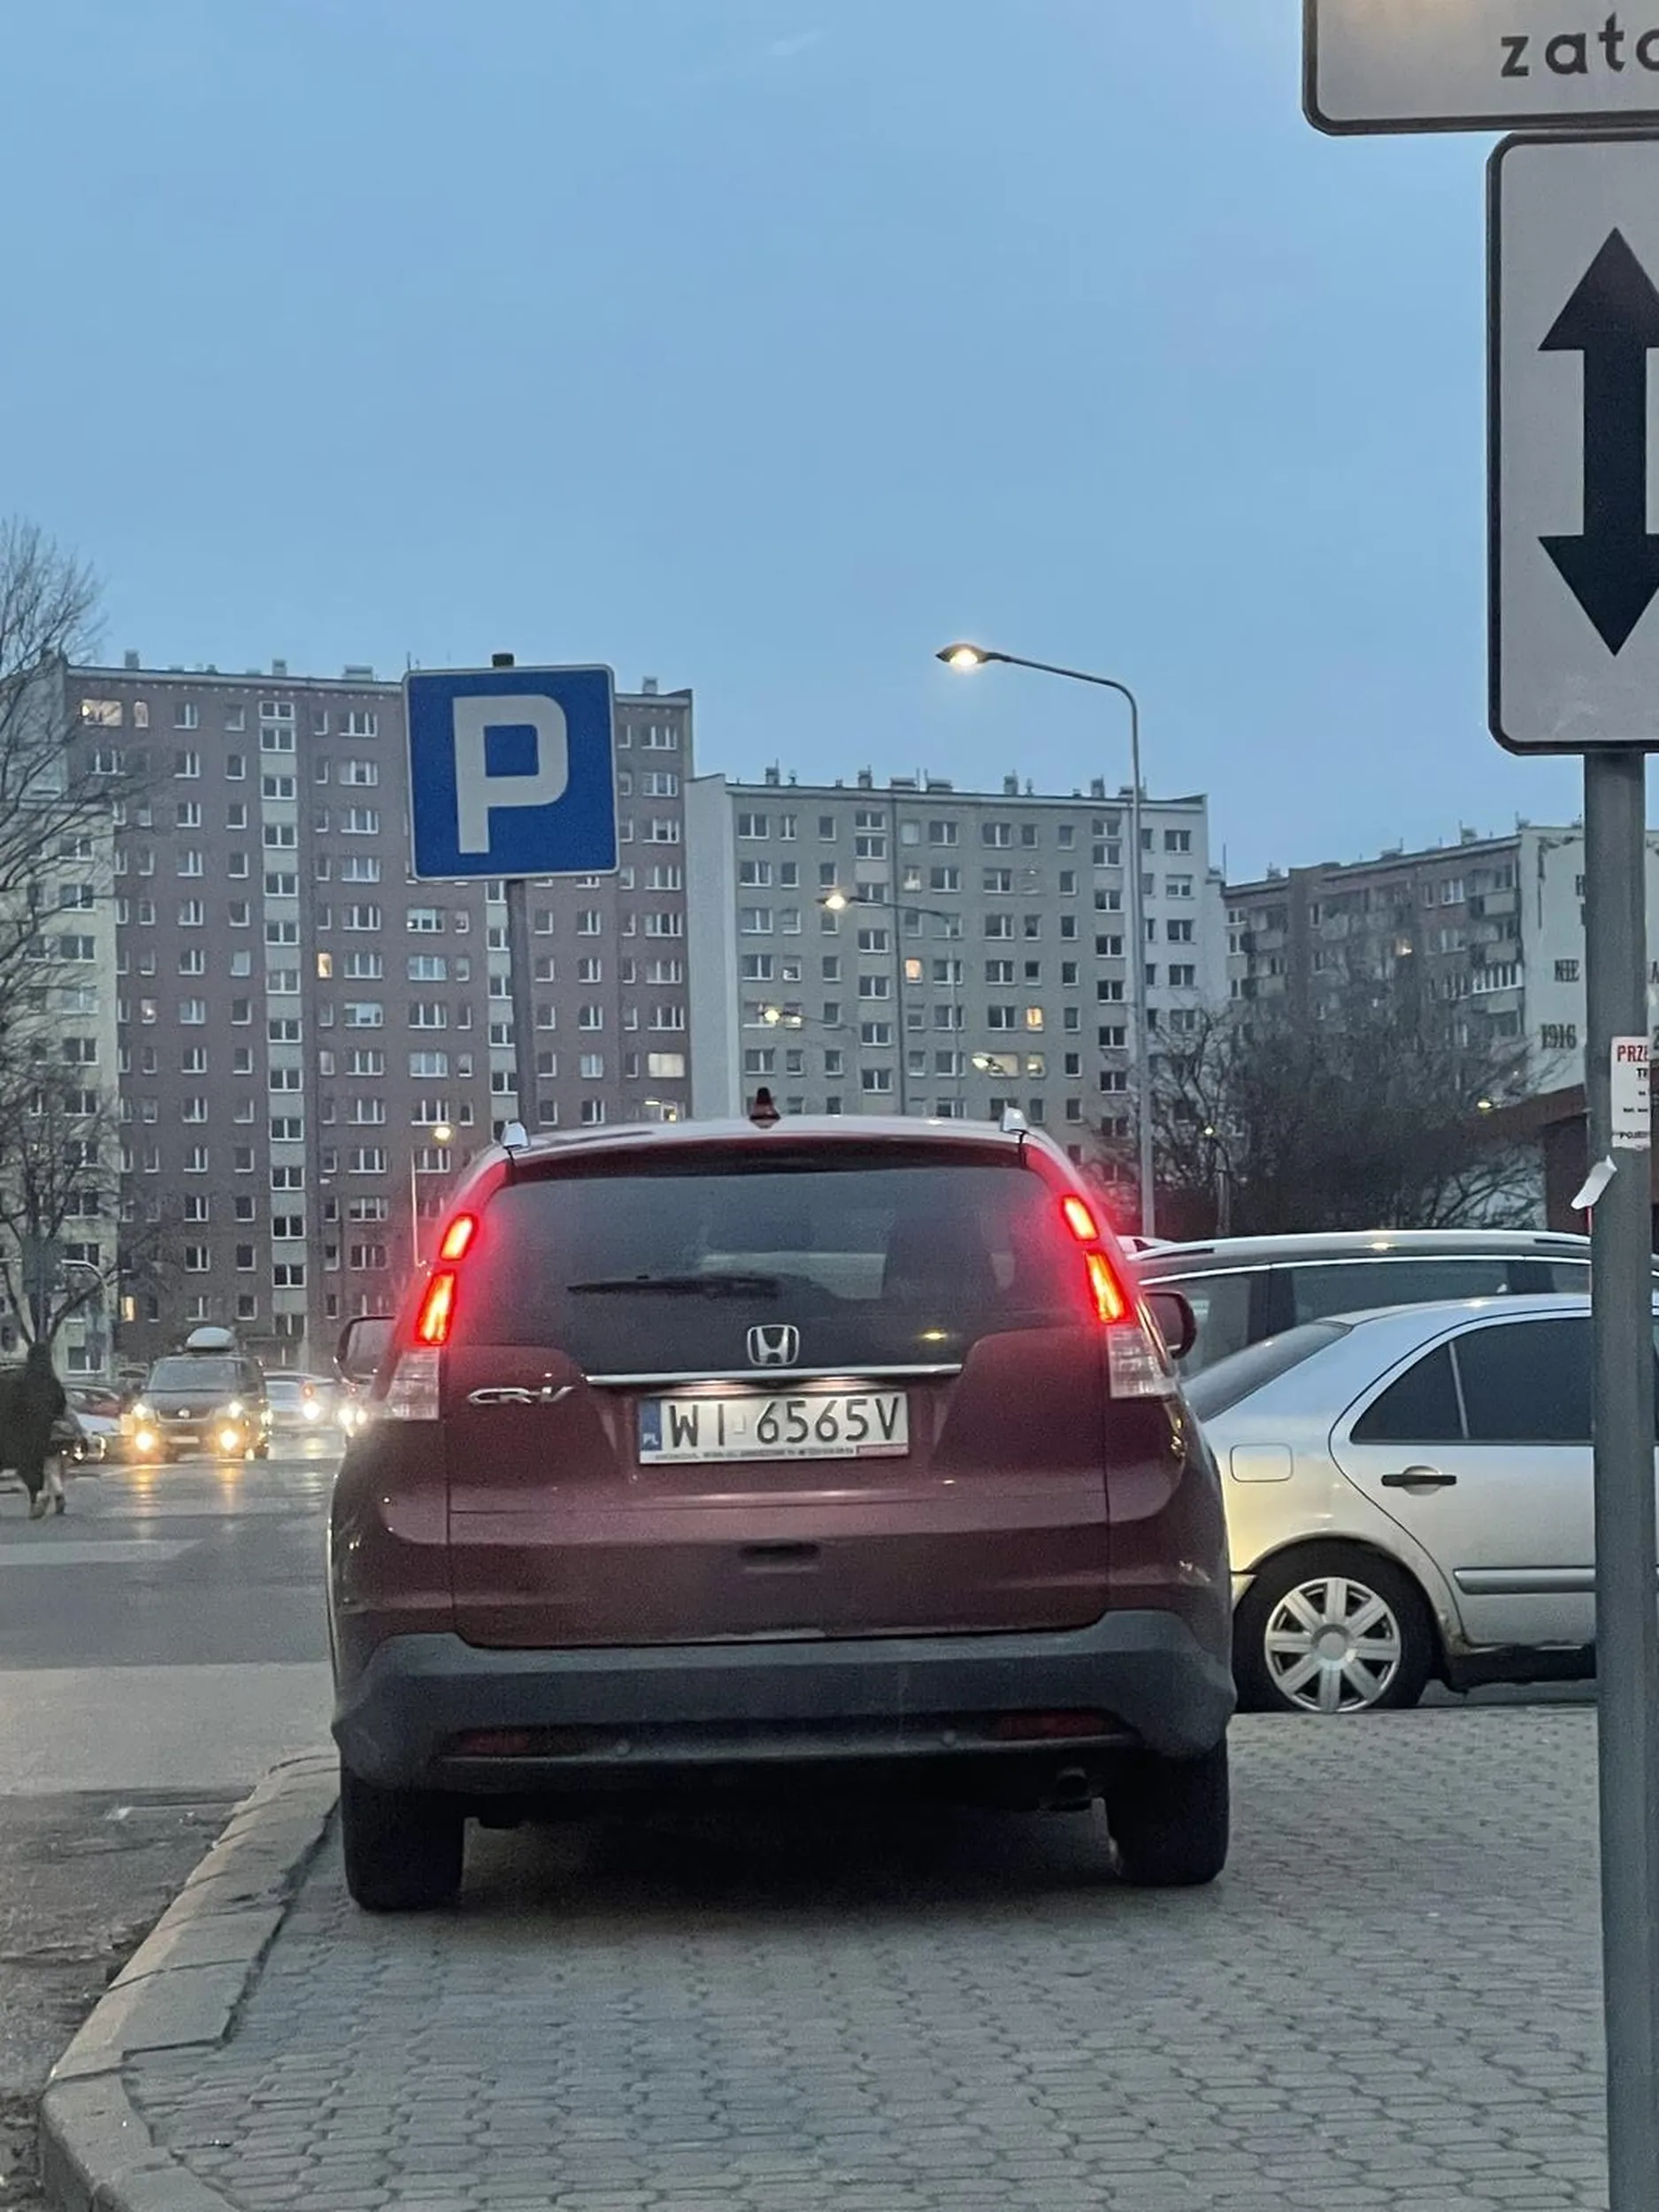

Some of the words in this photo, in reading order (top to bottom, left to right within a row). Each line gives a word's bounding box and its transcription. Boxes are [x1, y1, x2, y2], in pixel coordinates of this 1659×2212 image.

[453, 695, 569, 854] P
[1540, 1024, 1577, 1049] 1916
[643, 1432, 659, 1446] PL
[669, 1403, 725, 1448] WI
[757, 1397, 899, 1444] 6565V
